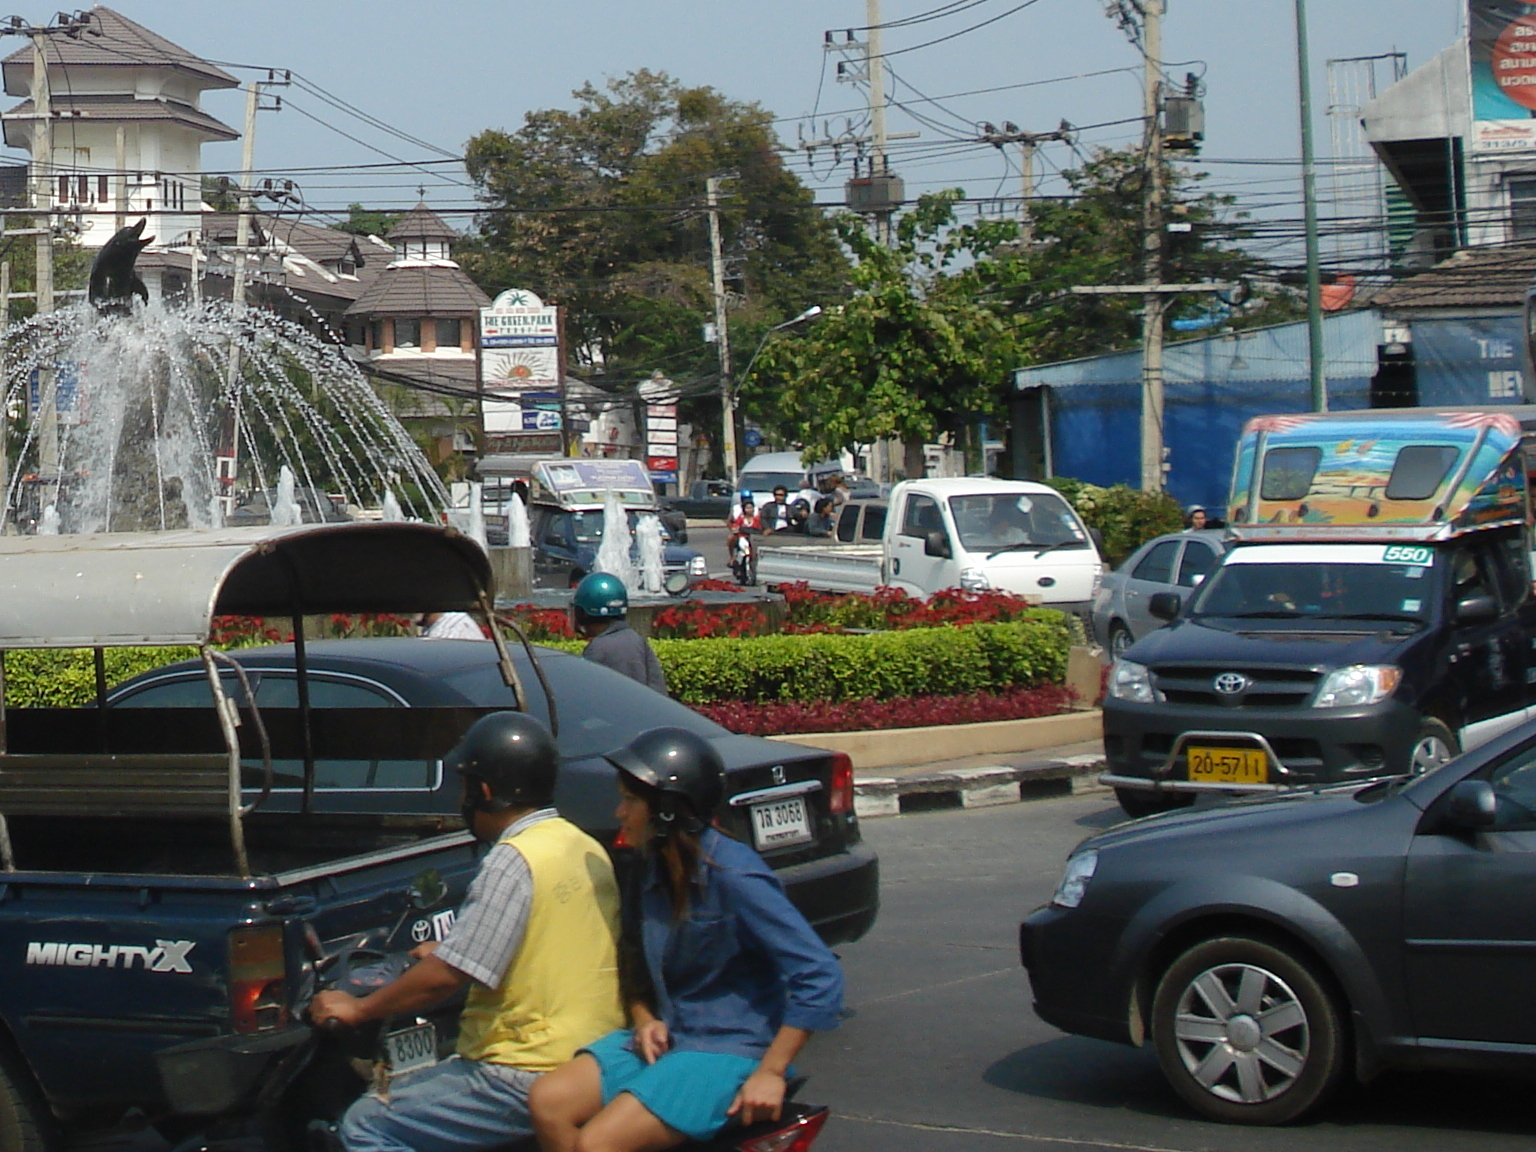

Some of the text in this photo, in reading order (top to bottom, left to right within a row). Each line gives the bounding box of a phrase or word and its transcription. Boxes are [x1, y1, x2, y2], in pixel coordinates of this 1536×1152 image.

[531, 314, 553, 325] PARK
[1385, 546, 1428, 562] 550
[1193, 754, 1259, 776] 20-5711
[775, 801, 802, 826] 3068
[395, 1029, 433, 1062] 8300
